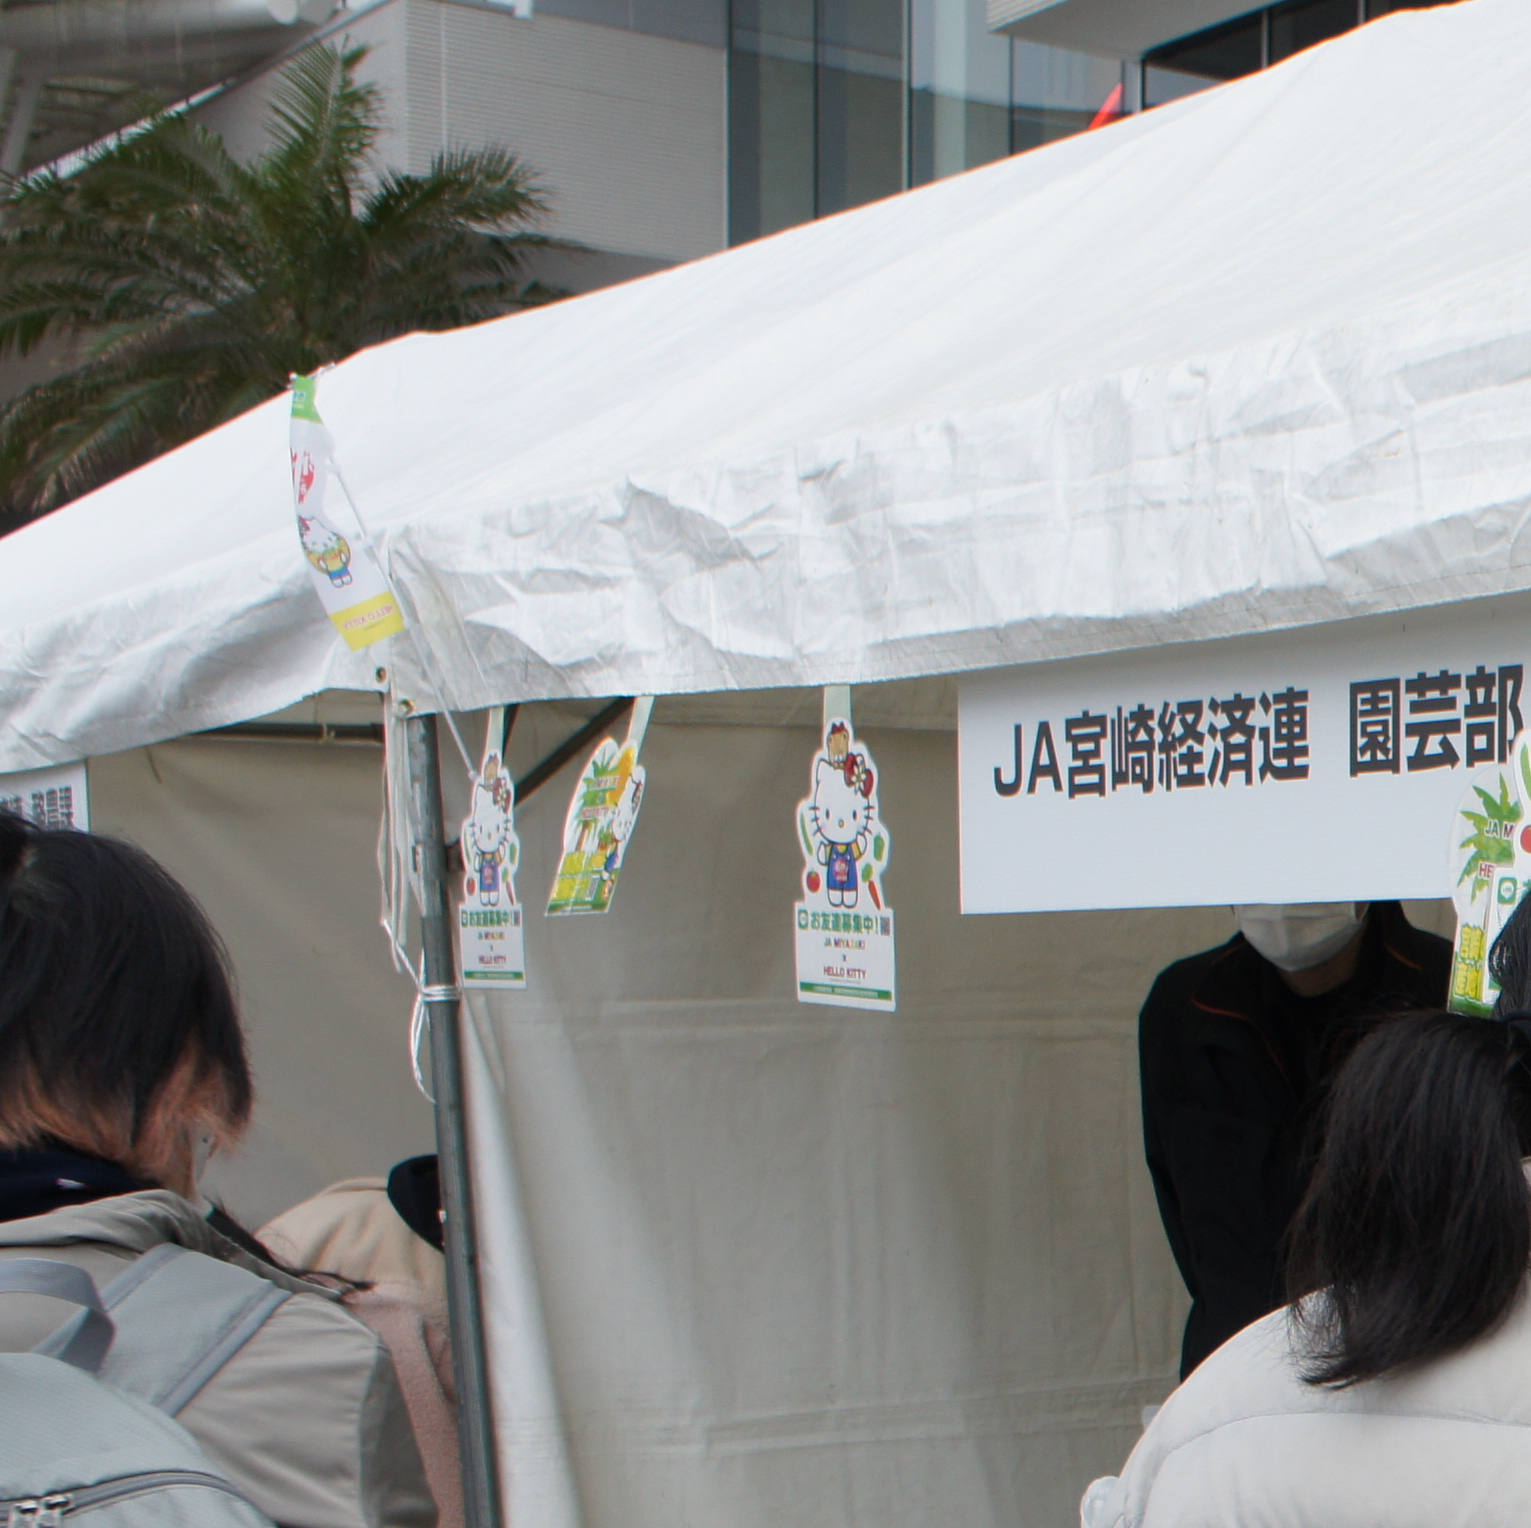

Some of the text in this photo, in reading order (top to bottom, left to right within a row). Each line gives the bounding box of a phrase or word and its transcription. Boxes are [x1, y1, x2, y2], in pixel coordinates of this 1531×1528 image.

[994, 663, 1526, 800] JA宮崎経済連 園芸部
